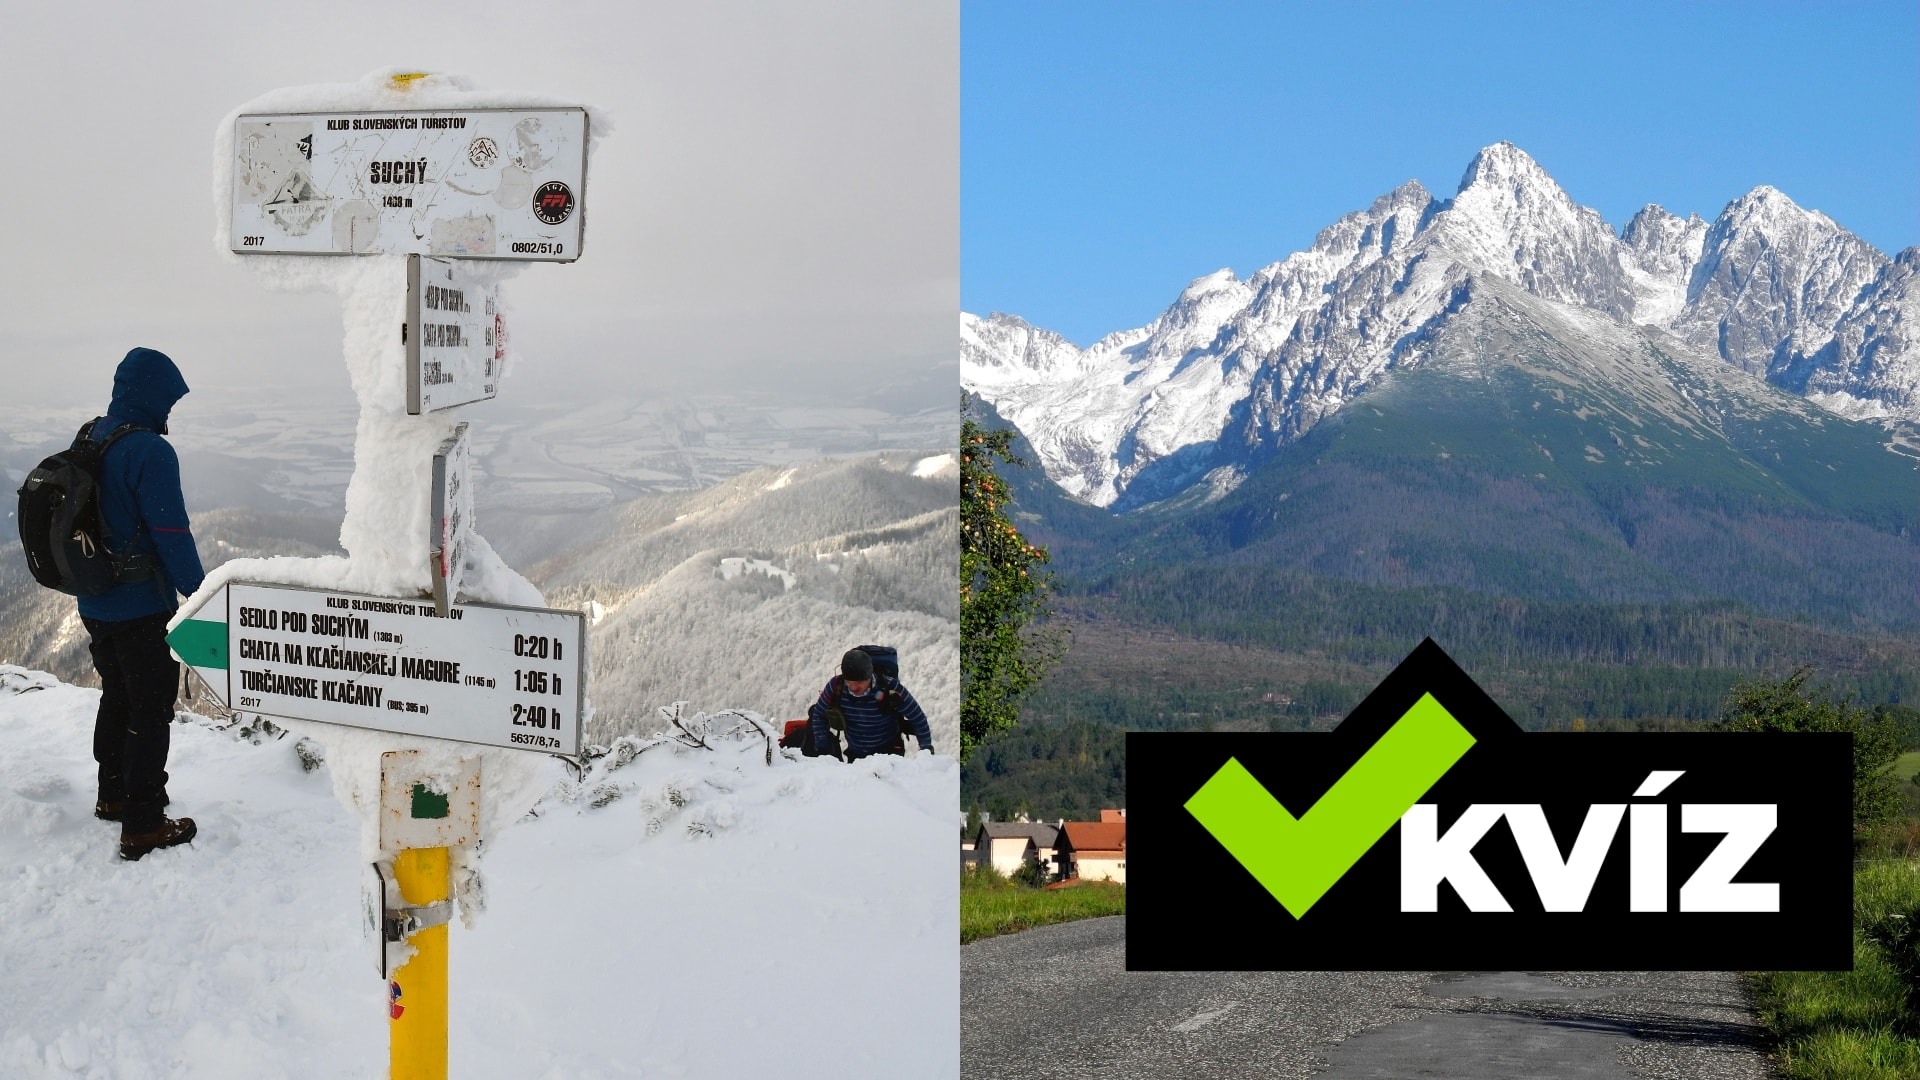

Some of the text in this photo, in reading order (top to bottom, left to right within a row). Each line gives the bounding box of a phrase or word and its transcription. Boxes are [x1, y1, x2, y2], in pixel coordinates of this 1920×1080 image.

[327, 117, 467, 130] KLUB SLOVENSKÝCH TURISTOV
[371, 157, 427, 184] SUCHÝ
[404, 198, 413, 208] m
[243, 235, 265, 246] 2017
[511, 242, 563, 255] 0802/51,0
[326, 597, 463, 620] KLUB SLOVENSKÝCH TUROV
[240, 606, 403, 645] SEDLO POD SUCHÝM (1303 m)
[514, 633, 563, 661] 0:20 h
[240, 638, 496, 690] CHATA NA KĽAČIANSKEJ MAGURE (1145 m)
[240, 668, 429, 715] TURČIANSKE KĽAČANY (BUS; 395 m)
[514, 669, 562, 696] 1:05 h
[240, 697, 261, 708] 2017
[512, 703, 561, 731] 2:40 h
[510, 733, 561, 748] 5637/8,7a
